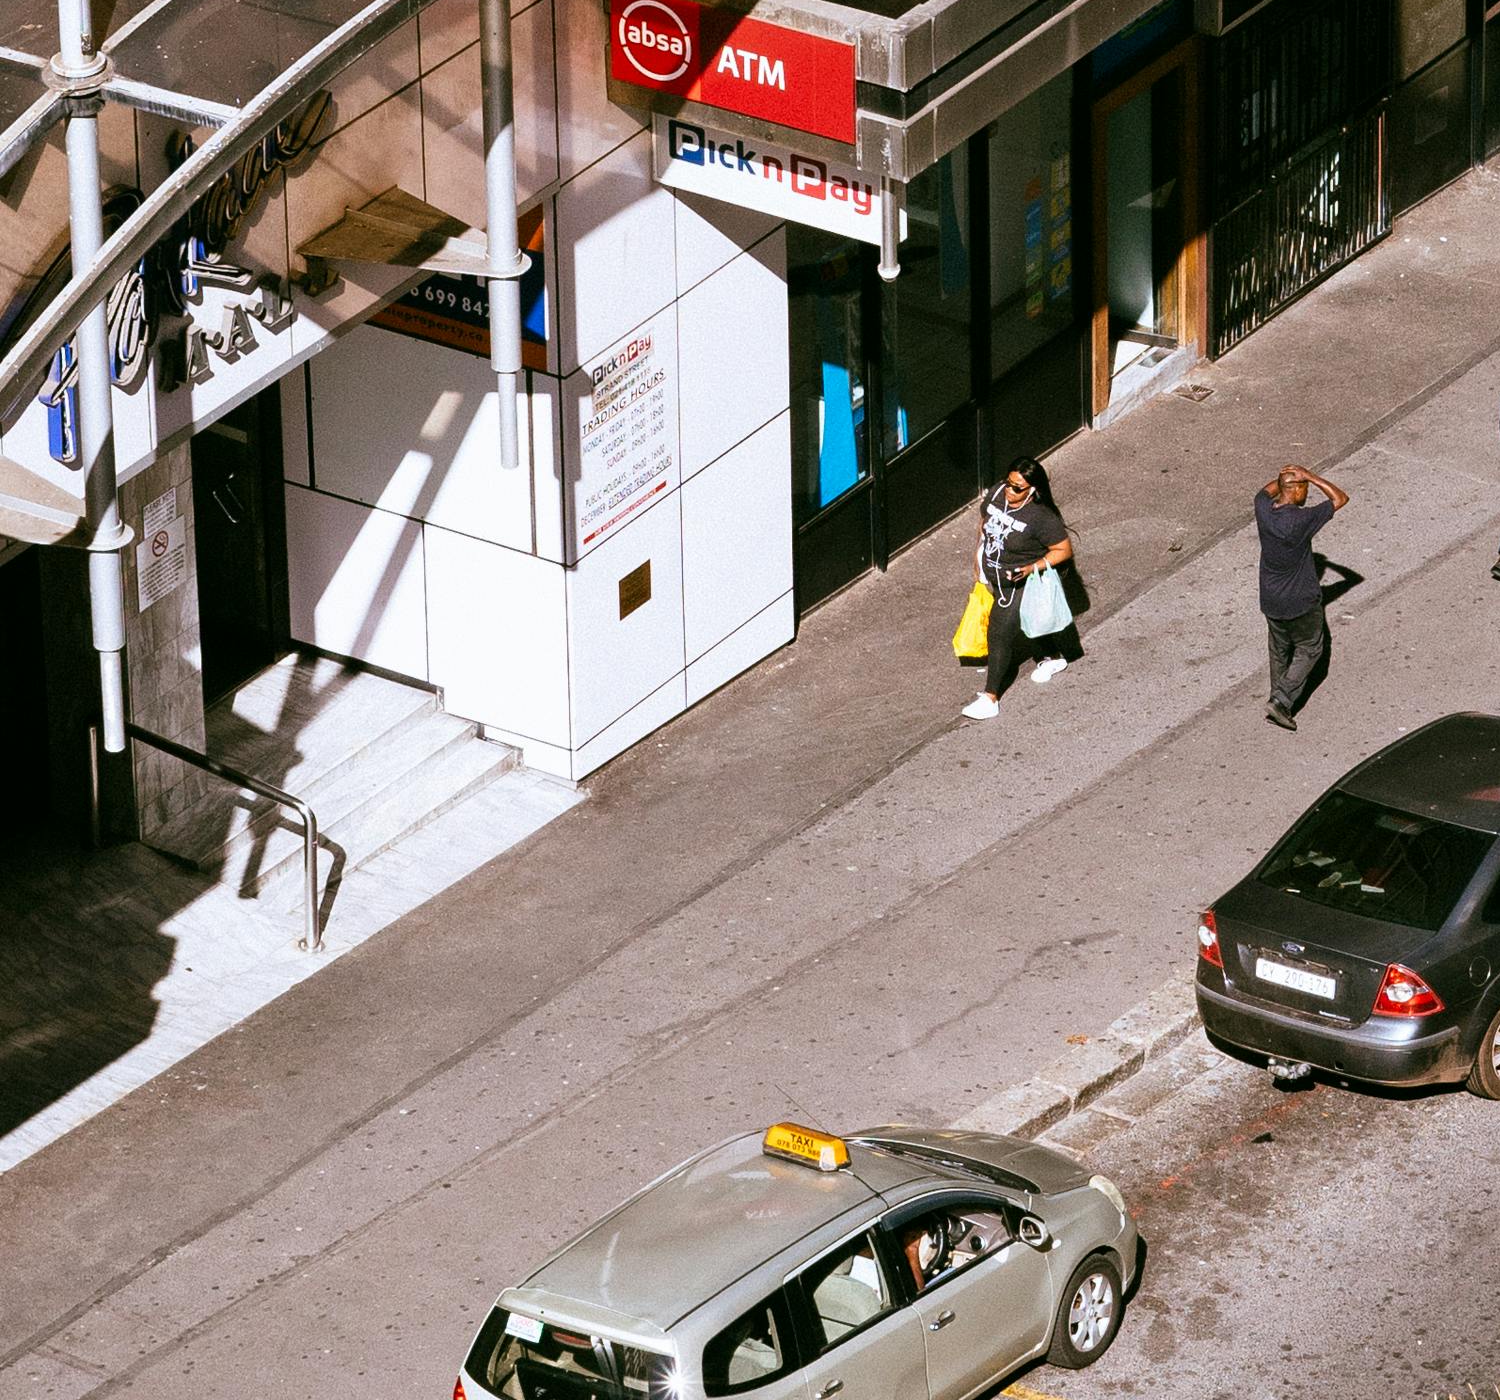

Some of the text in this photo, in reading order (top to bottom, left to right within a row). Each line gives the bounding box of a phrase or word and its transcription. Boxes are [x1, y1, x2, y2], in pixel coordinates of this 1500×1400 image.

[627, 21, 787, 91] absa ATM
[668, 119, 873, 216] Pick n Pay
[425, 286, 457, 308] 699
[592, 335, 652, 387] Pick n Pay
[596, 354, 649, 399] STRAND STREET
[582, 367, 665, 436] TRADING HOURS
[790, 1132, 814, 1148] TAXI
